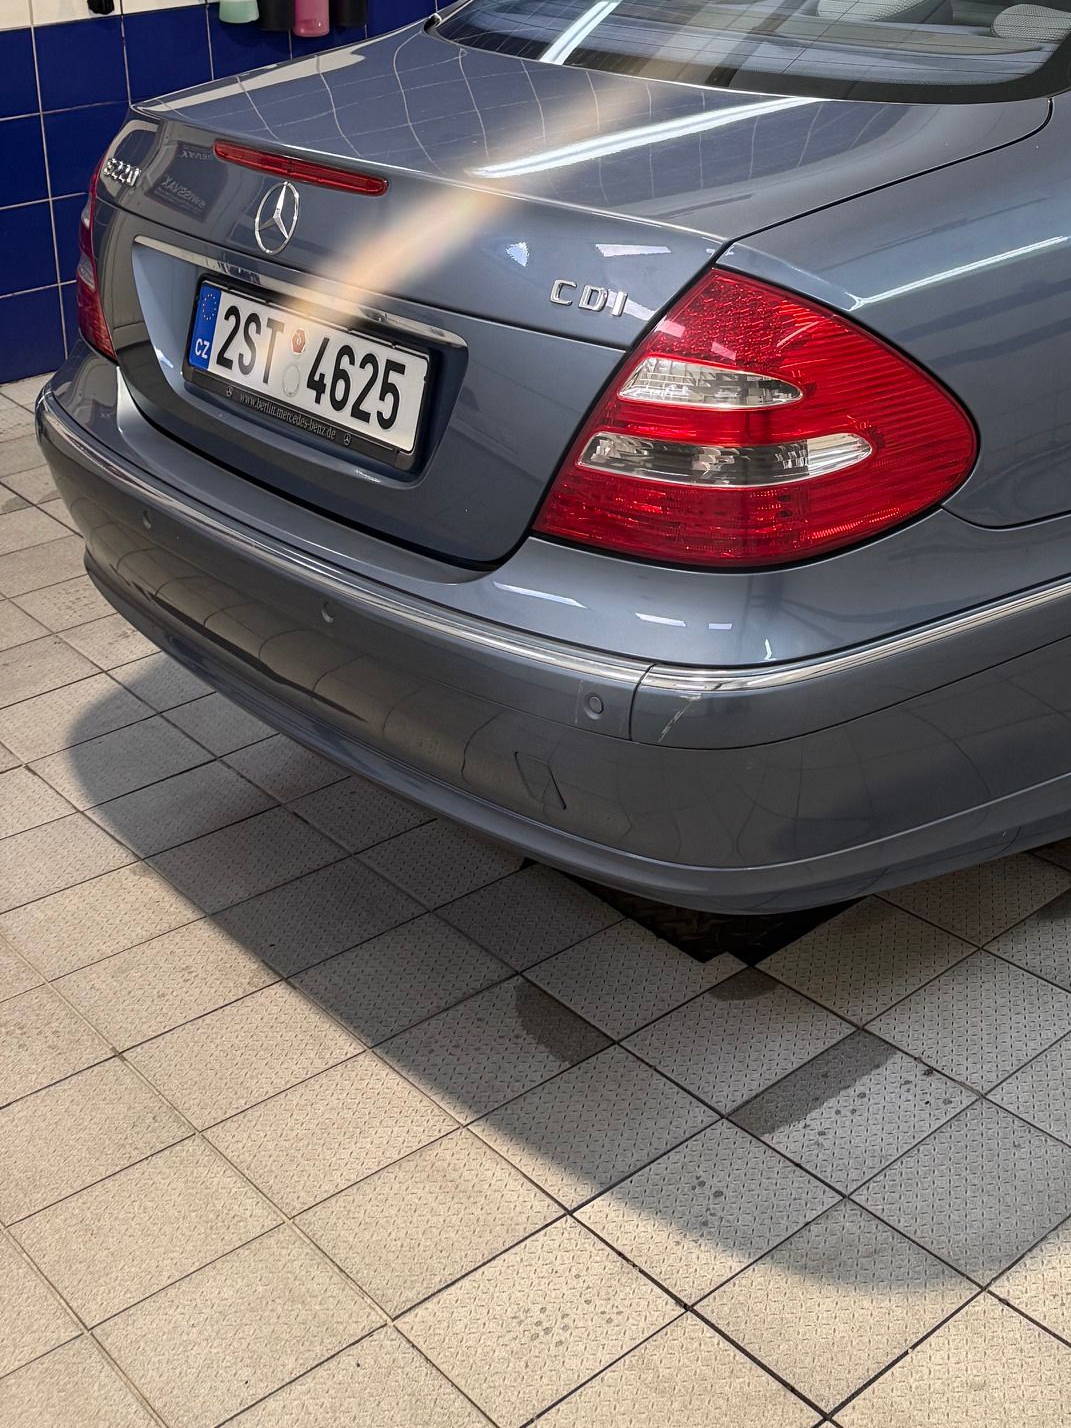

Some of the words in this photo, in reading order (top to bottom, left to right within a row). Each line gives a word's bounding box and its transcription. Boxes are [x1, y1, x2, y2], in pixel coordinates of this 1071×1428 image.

[550, 279, 628, 317] CDI
[195, 338, 210, 359] CZ
[216, 305, 286, 385] 2ST
[306, 337, 406, 430] 4625
[240, 392, 336, 440] www.berlin.mercedes-benz.de
